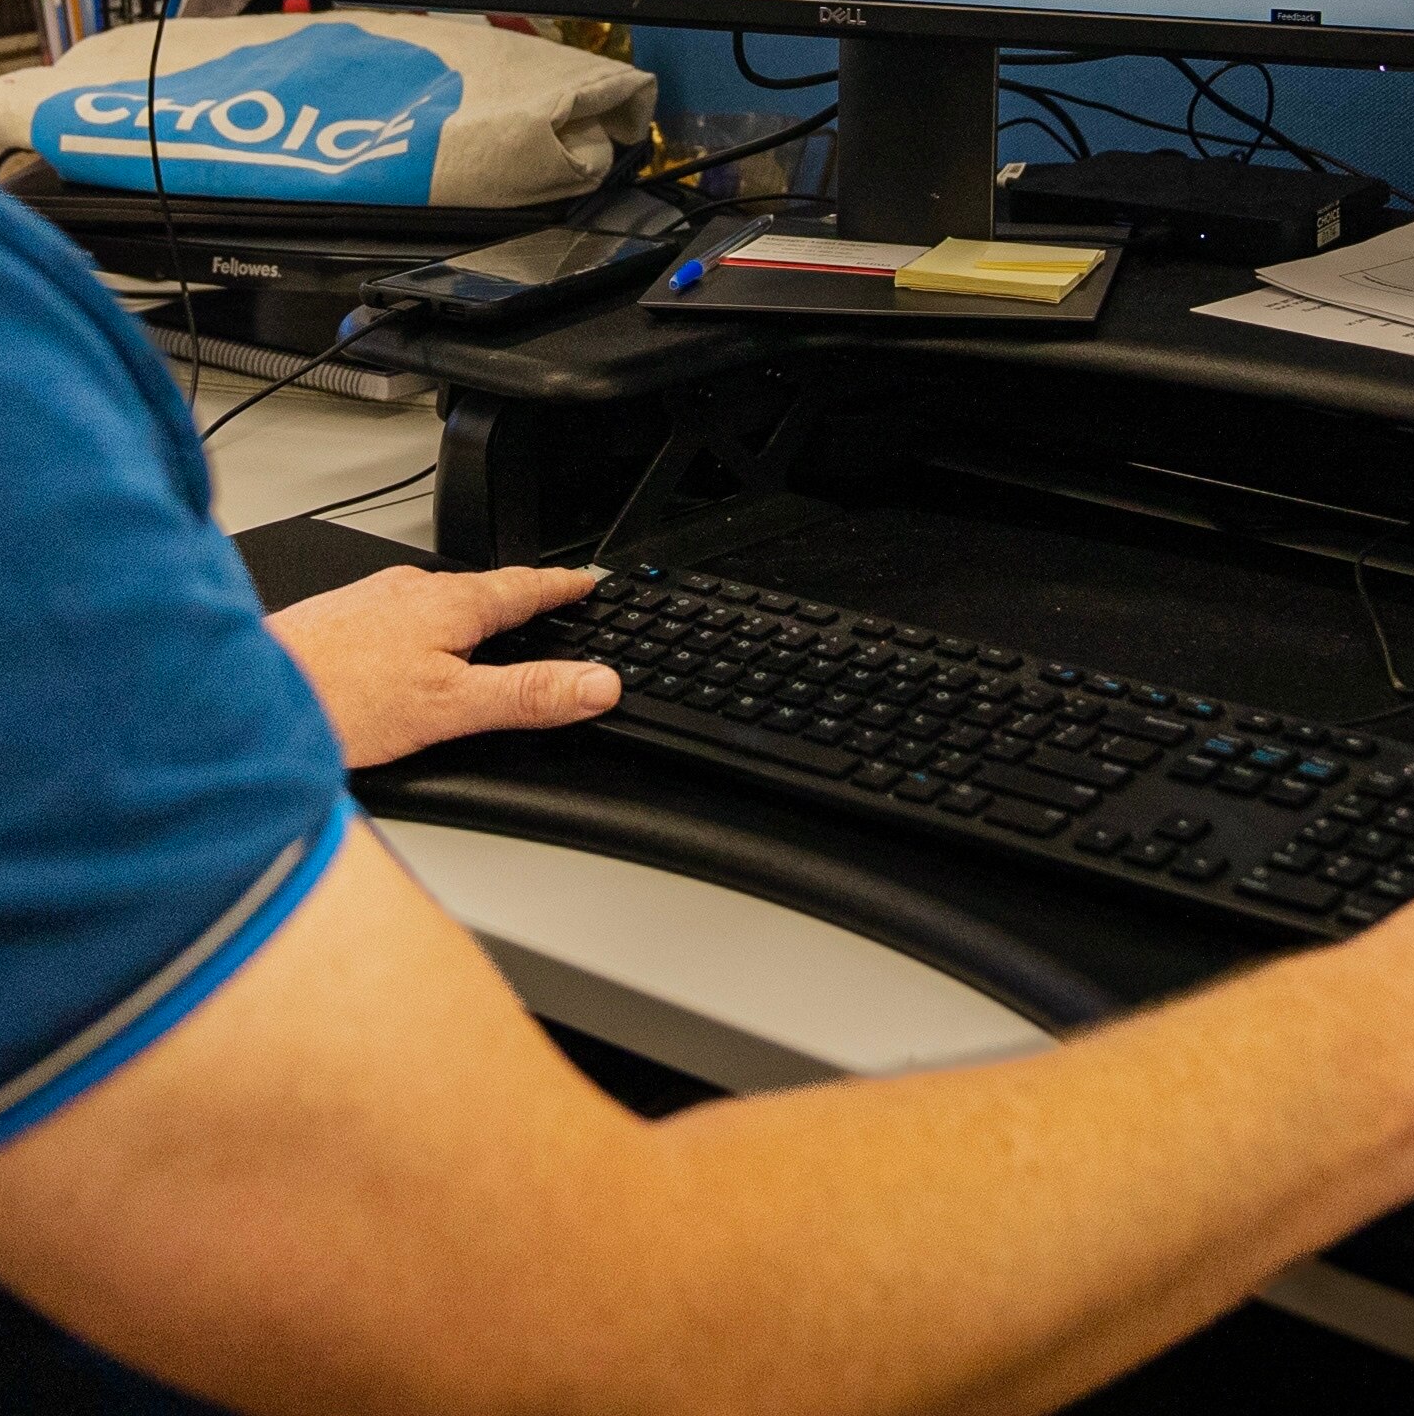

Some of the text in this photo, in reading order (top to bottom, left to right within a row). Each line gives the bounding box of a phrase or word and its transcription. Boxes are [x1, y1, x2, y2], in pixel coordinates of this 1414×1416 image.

[819, 6, 867, 26] DELL
[1277, 12, 1315, 22] Feedback
[74, 90, 432, 159] CHOICE
